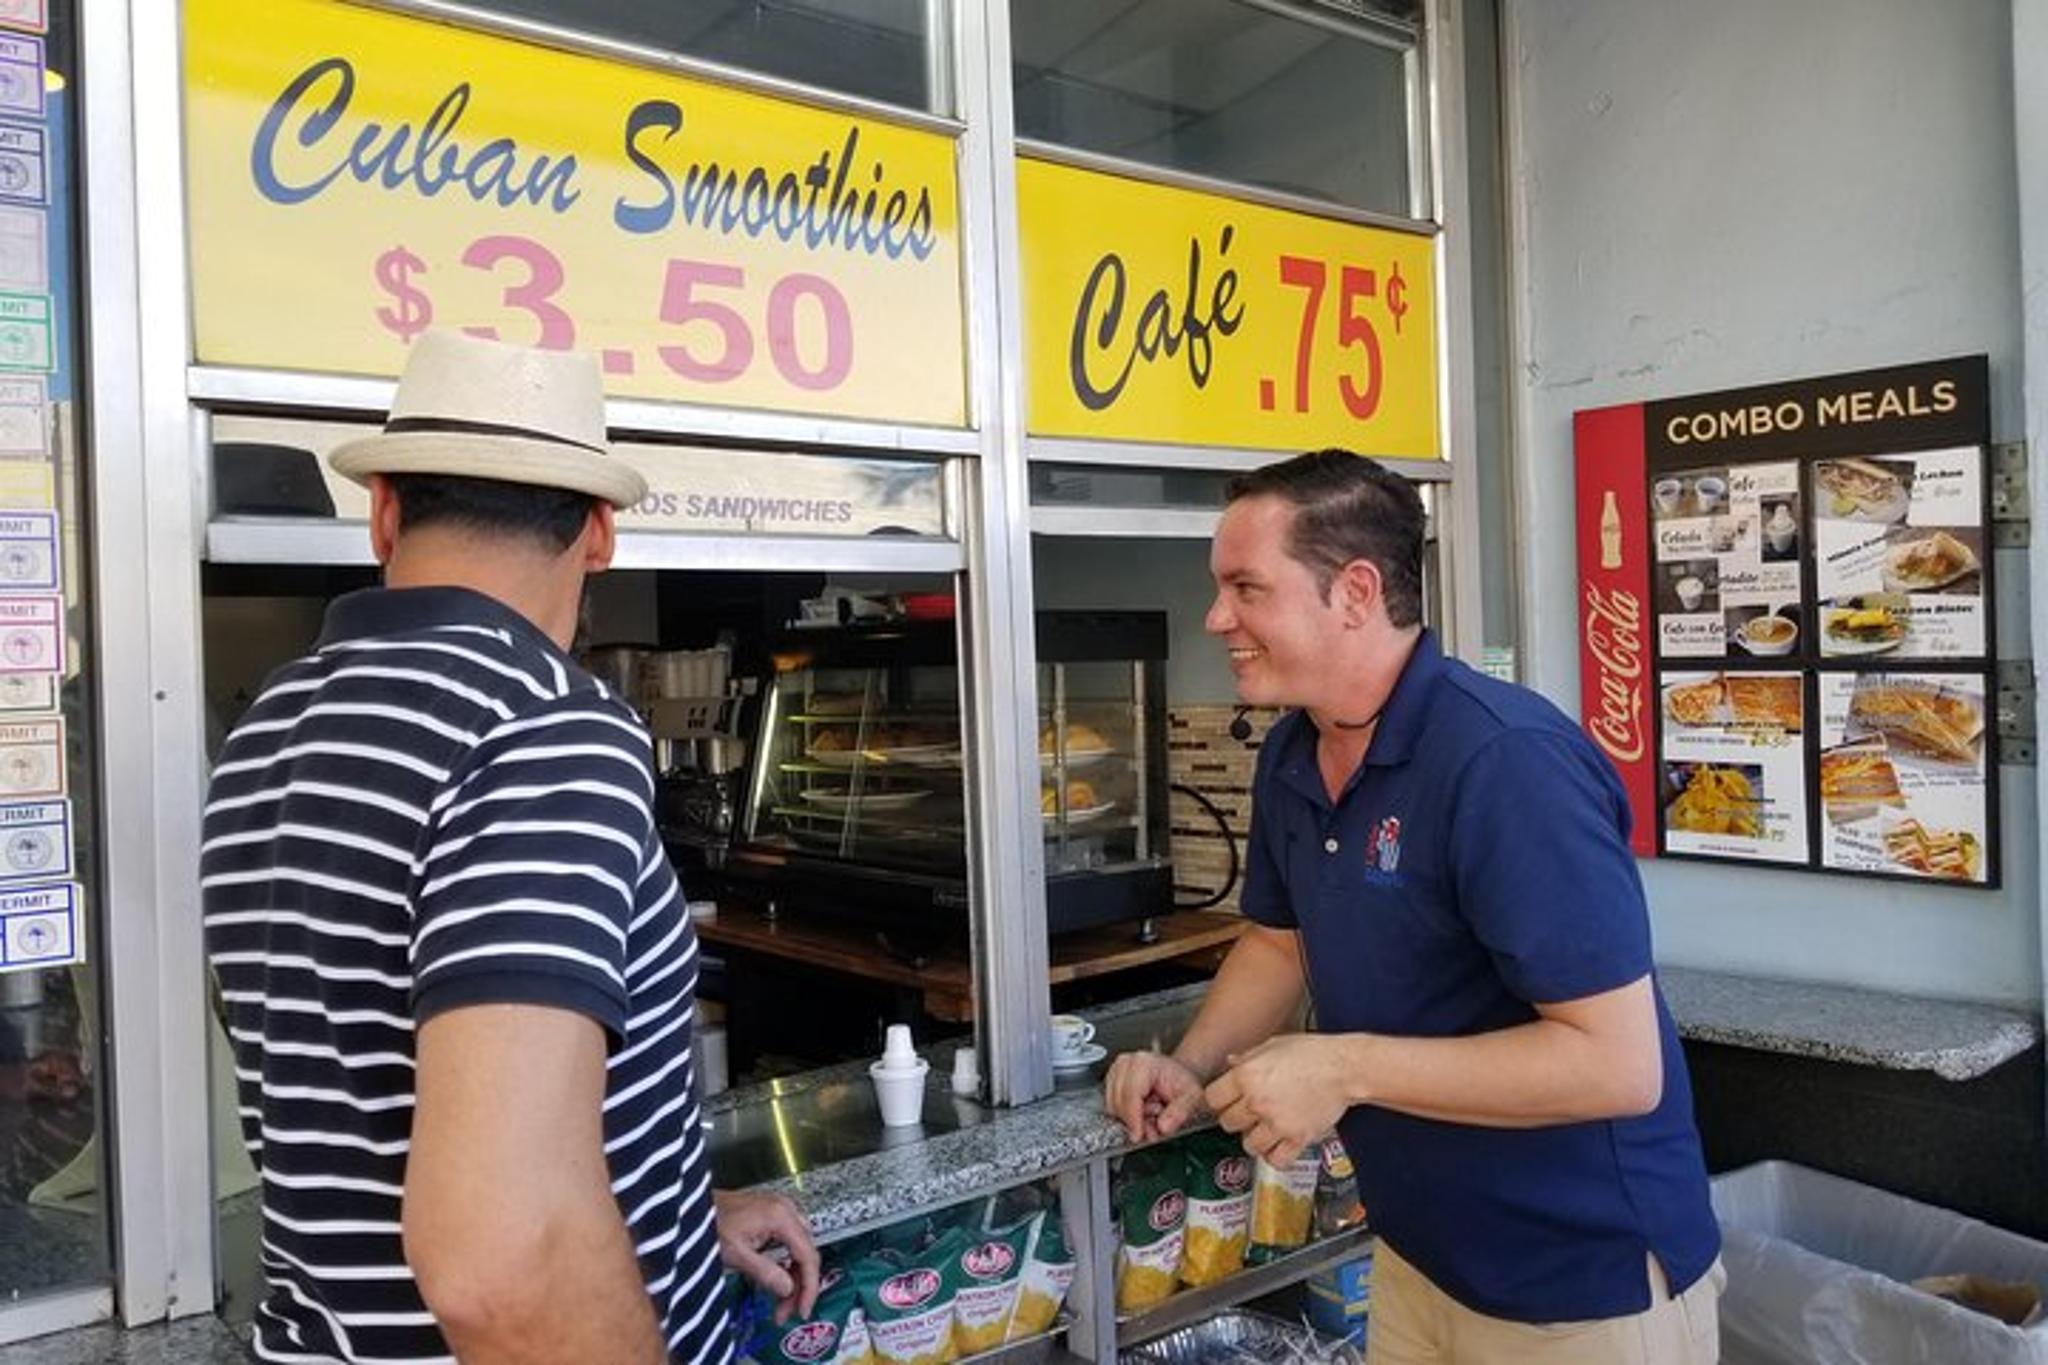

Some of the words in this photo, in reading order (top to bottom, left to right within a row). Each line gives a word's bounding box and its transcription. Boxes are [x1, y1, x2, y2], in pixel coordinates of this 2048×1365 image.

[250, 57, 581, 213] Cuban
[614, 99, 937, 262] Smoothies
[1069, 224, 1245, 411] Café
[1667, 403, 1804, 444] COMBO
[1818, 380, 1957, 426] MEALS
[629, 491, 679, 515] OS
[686, 495, 853, 523] SANDWICHES
[0, 806, 46, 821] RMIT
